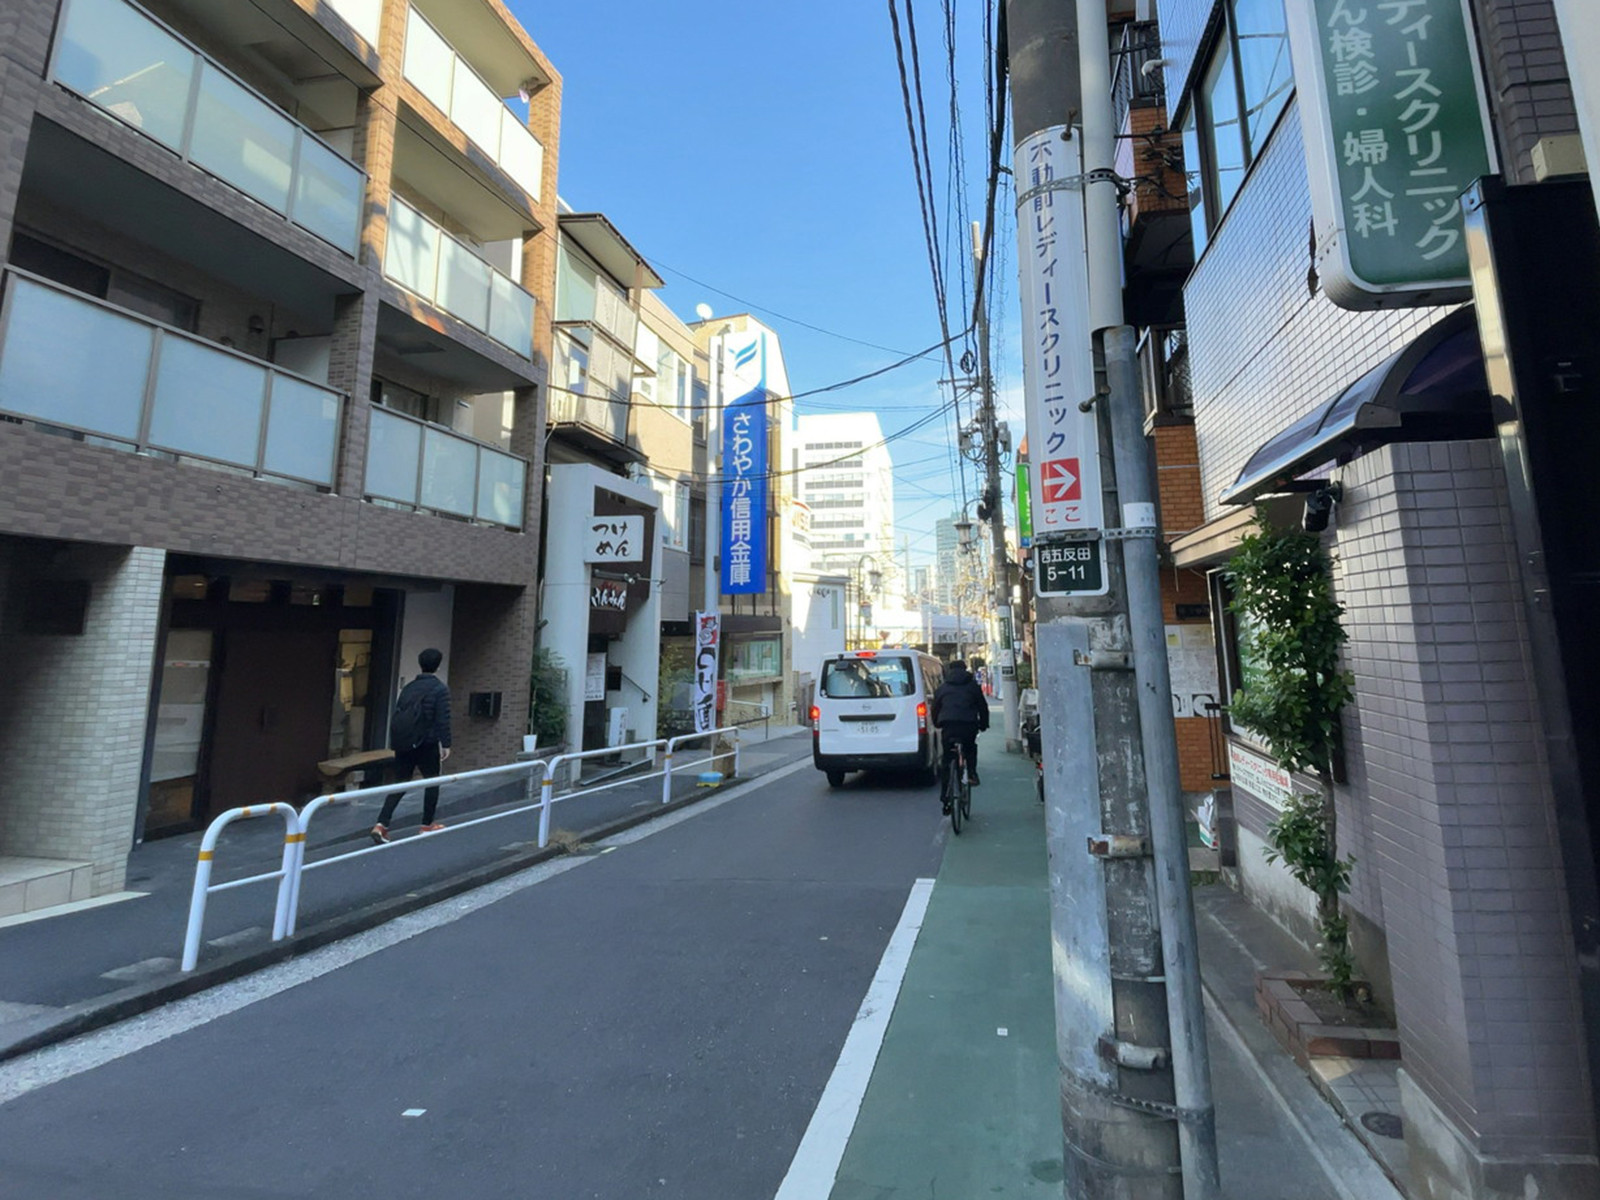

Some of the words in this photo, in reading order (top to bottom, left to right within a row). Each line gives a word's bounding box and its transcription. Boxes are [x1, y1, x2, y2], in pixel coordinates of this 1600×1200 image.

[1030, 140, 1067, 455] 不動前レディースクリニック
[730, 413, 753, 586] さわやか信用金庫
[1045, 506, 1080, 524] ここ
[592, 521, 628, 538] つけ
[596, 539, 630, 557] めん
[1041, 547, 1091, 563] 西五反田
[1047, 565, 1085, 581] 5-11
